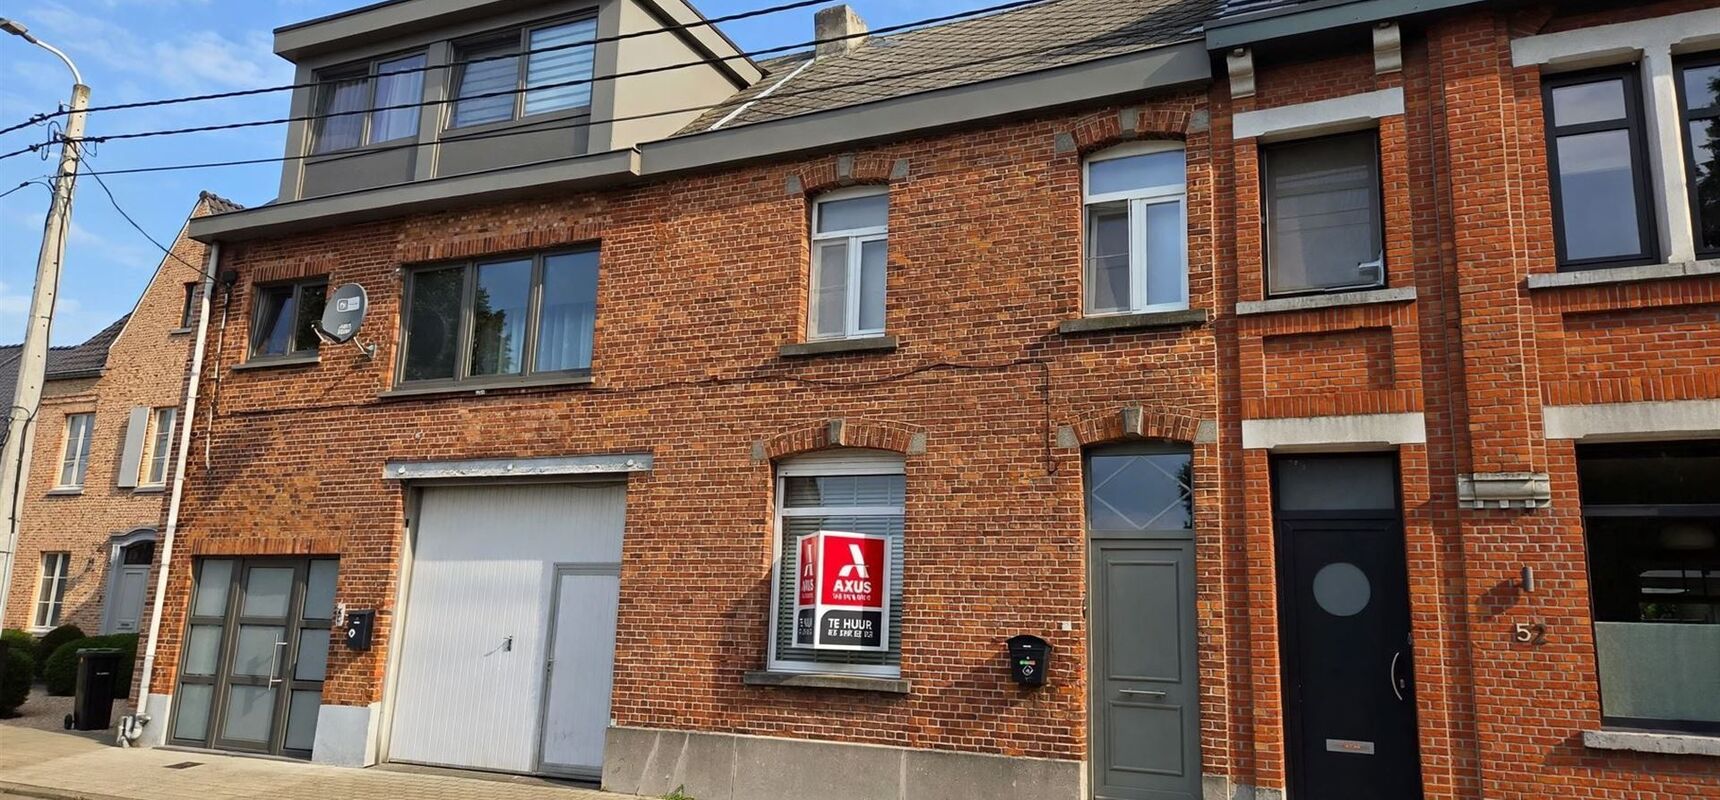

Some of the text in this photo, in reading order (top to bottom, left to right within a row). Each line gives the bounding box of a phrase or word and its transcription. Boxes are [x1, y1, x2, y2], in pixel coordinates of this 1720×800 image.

[833, 580, 872, 594] AXUS
[828, 618, 873, 630] TE HUUR
[1516, 623, 1546, 645] 52
